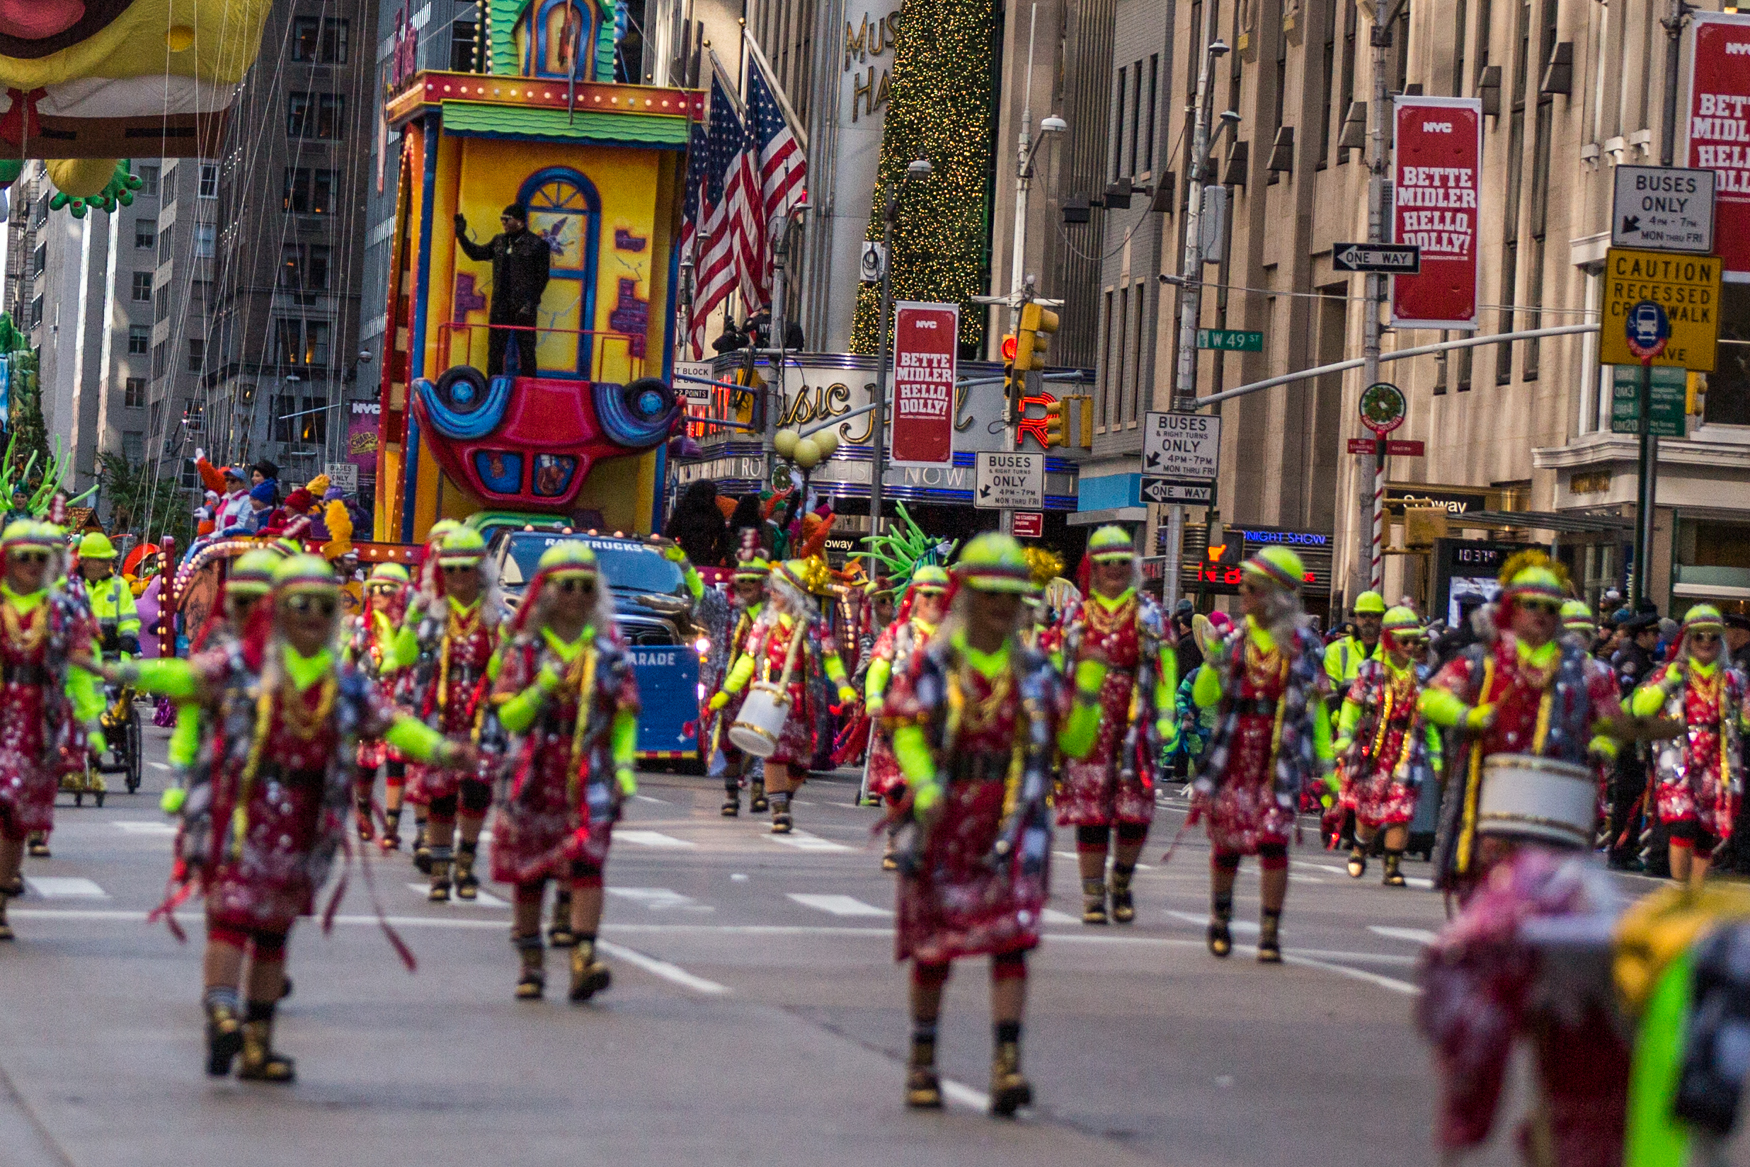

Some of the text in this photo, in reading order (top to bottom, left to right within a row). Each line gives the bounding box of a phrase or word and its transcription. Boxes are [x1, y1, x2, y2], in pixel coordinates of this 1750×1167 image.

[844, 10, 901, 73] MUS
[852, 65, 892, 124] HA
[1423, 122, 1453, 134] NYC
[1691, 116, 1750, 143] MIDL
[1402, 166, 1472, 187] BETTE
[1635, 174, 1698, 194] BUSES
[1397, 187, 1477, 209] MIDLER
[1641, 195, 1689, 214] ONLY
[1402, 210, 1472, 235] HELLO,
[1402, 231, 1471, 255] DOLLY!
[1640, 230, 1703, 244] MON THRU FRI
[1345, 251, 1370, 264] ONE
[1381, 253, 1408, 266] WAY
[1615, 256, 1712, 283] CAUTION
[1613, 282, 1712, 306] RECESSED
[915, 320, 938, 329] NYC
[1212, 332, 1260, 348] W 49 ST
[900, 352, 950, 368] BETTE
[682, 367, 709, 376] BLOCK
[896, 366, 953, 383] MIDLER
[684, 389, 707, 398] POINTS
[900, 384, 949, 401] HELLO,
[352, 402, 381, 415] NYC
[899, 398, 948, 416] DOLLY!
[1158, 415, 1207, 432] BUSES
[1377, 415, 1402, 432] HOLIDAYS
[1185, 432, 1209, 440] TURNS
[1162, 439, 1201, 453] ONLY
[988, 456, 1032, 468] BUSES
[1162, 464, 1215, 475] MON THRU FRI
[904, 467, 964, 487] NOW
[992, 475, 1027, 488] ONLY
[1152, 485, 1208, 499] ONE WAY
[994, 497, 1010, 505] MON
[1028, 497, 1040, 505] FRI
[584, 539, 643, 553] TRUCKS
[1287, 532, 1327, 545] SHOW
[627, 652, 676, 666] ARADE
